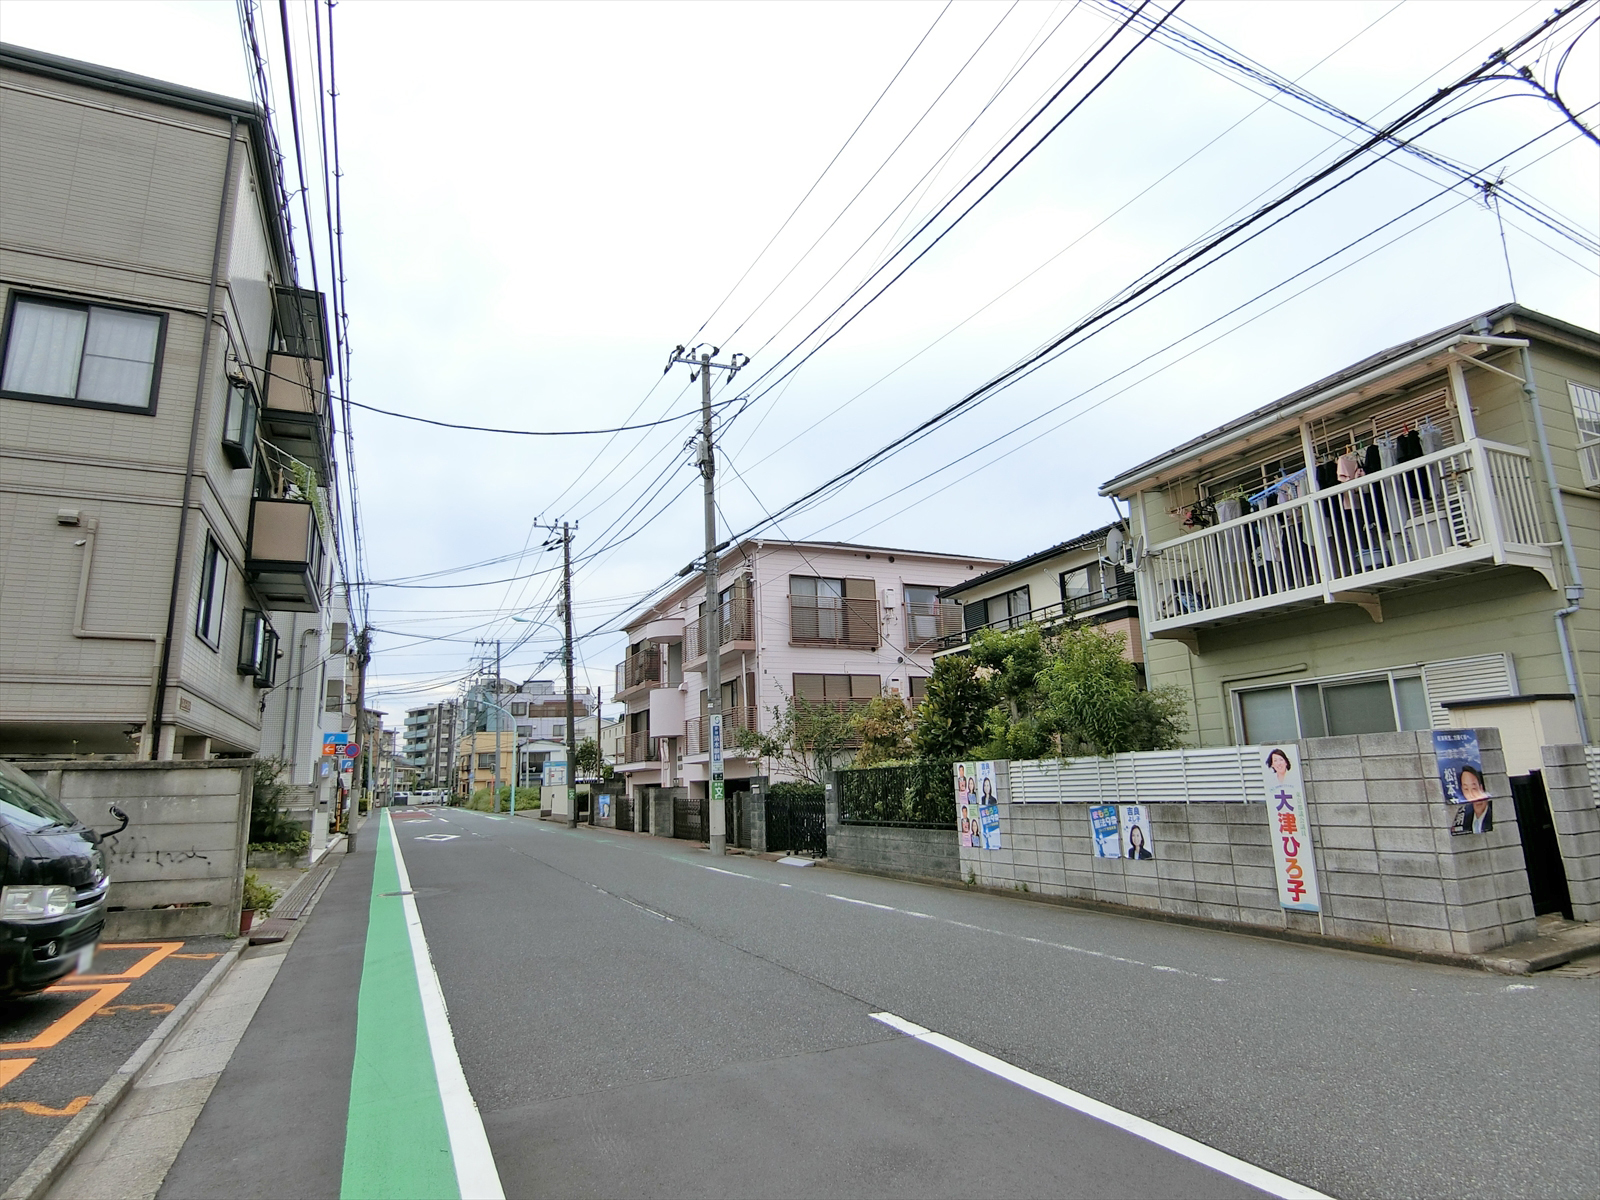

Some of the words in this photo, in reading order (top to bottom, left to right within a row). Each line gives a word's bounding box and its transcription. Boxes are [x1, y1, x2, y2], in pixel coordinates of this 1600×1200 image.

[1126, 806, 1140, 816] 吉良
[1127, 815, 1141, 823] よし子
[1274, 789, 1307, 902] 大津ひろ子
